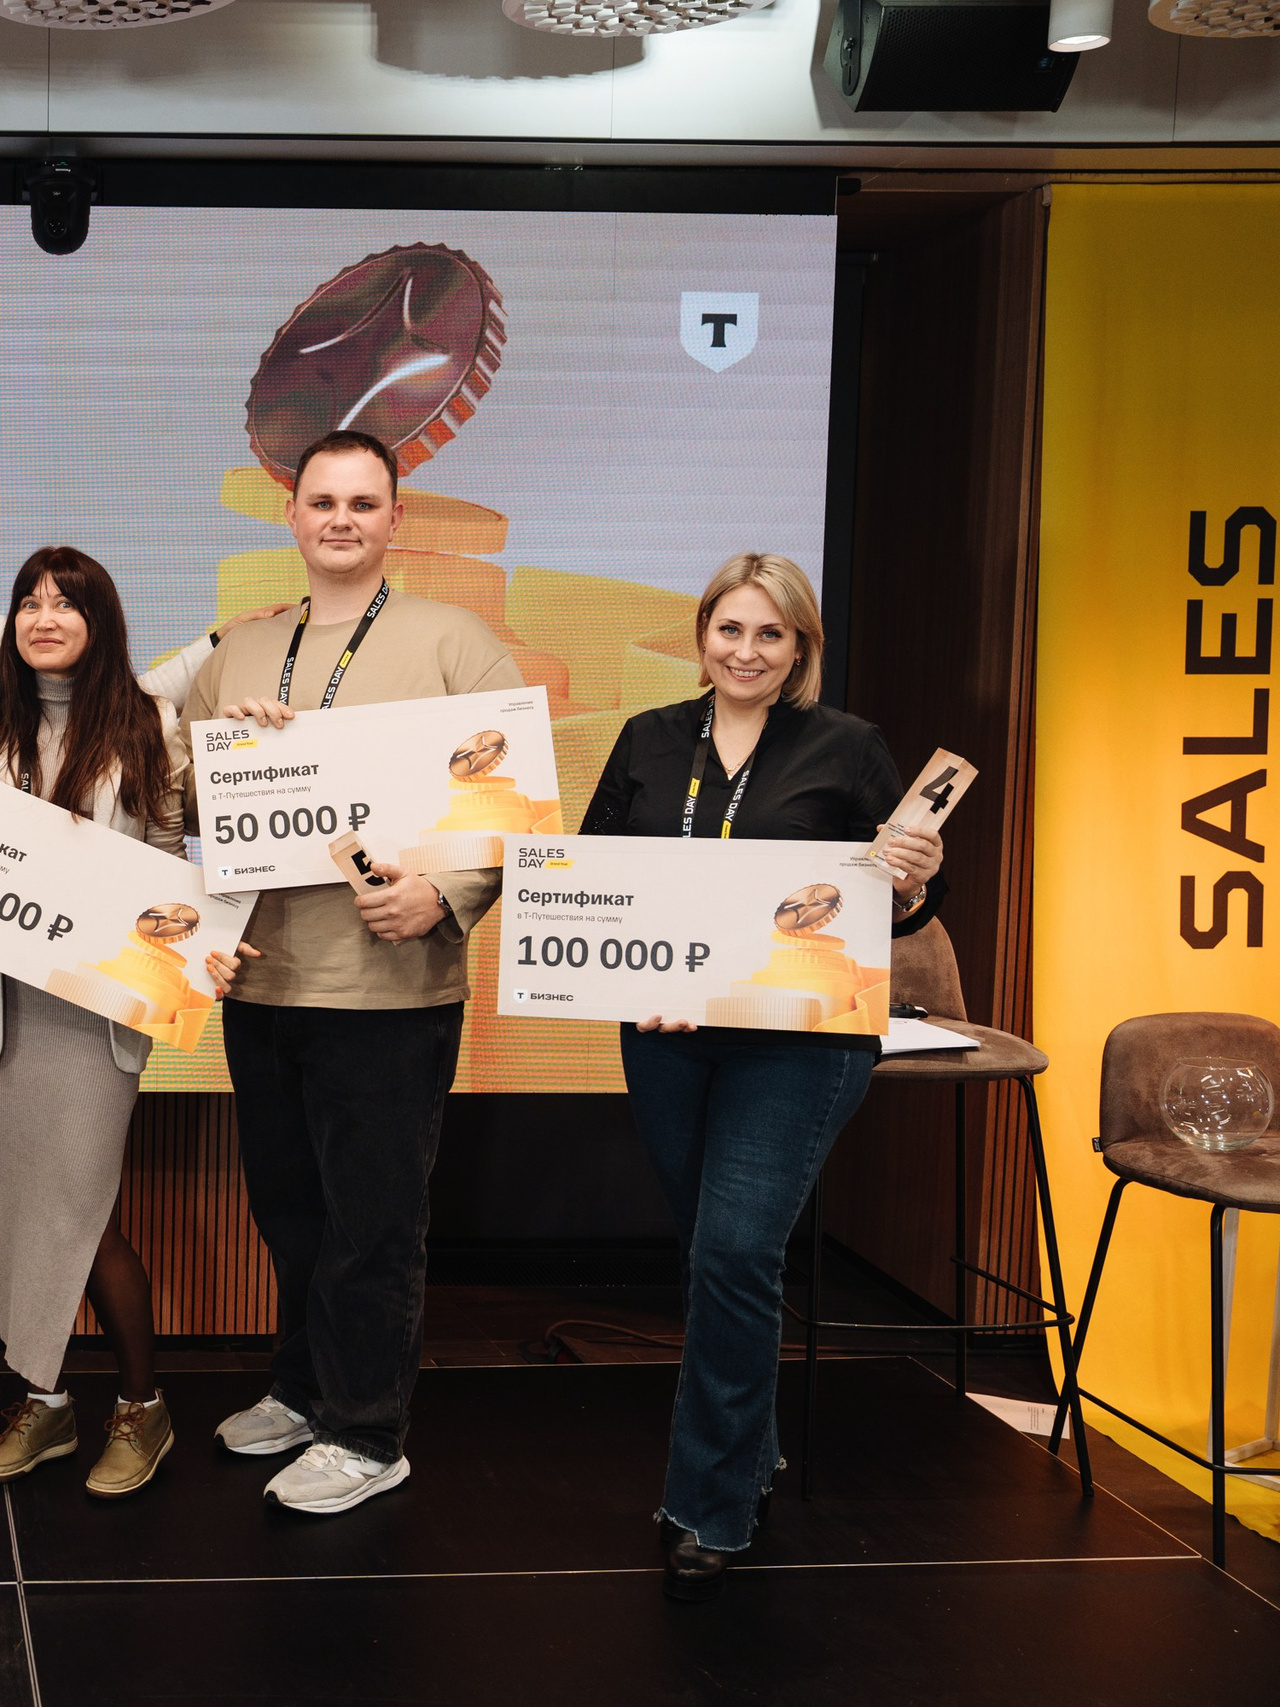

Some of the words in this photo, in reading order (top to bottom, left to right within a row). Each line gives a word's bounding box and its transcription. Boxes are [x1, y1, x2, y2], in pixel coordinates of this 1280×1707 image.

[366, 592, 386, 619] SALES
[281, 656, 295, 684] SALES
[280, 686, 288, 704] DAY
[322, 686, 336, 710] ALES
[331, 666, 344, 685] DAY
[701, 708, 714, 739] SALES
[1180, 506, 1277, 949] SALES
[206, 729, 250, 742] SALES
[206, 741, 232, 752] DAY
[21, 773, 29, 792] SAL
[210, 764, 320, 786] Сертификат
[218, 789, 275, 800] Т-Путешествия
[287, 785, 312, 795] сумму
[732, 770, 750, 801] SALES
[919, 765, 959, 815] 4
[684, 796, 696, 814] DAY
[724, 802, 738, 821] DAY
[215, 812, 259, 845] 50
[269, 805, 338, 840] 000
[348, 802, 371, 832] ₽
[682, 817, 692, 838] LES
[518, 847, 565, 859] SALES
[518, 858, 545, 868] DAY
[234, 865, 276, 875] БИЗНЕС
[351, 849, 385, 887] 5
[517, 888, 634, 908] Сертификат
[47, 913, 74, 942] ₽
[524, 912, 584, 922] Т-Путешествия
[597, 916, 623, 924] сумму
[517, 935, 589, 968] 100
[600, 938, 674, 972] 000
[685, 942, 711, 973] ₽
[530, 992, 574, 1002] БИЗНЕС
